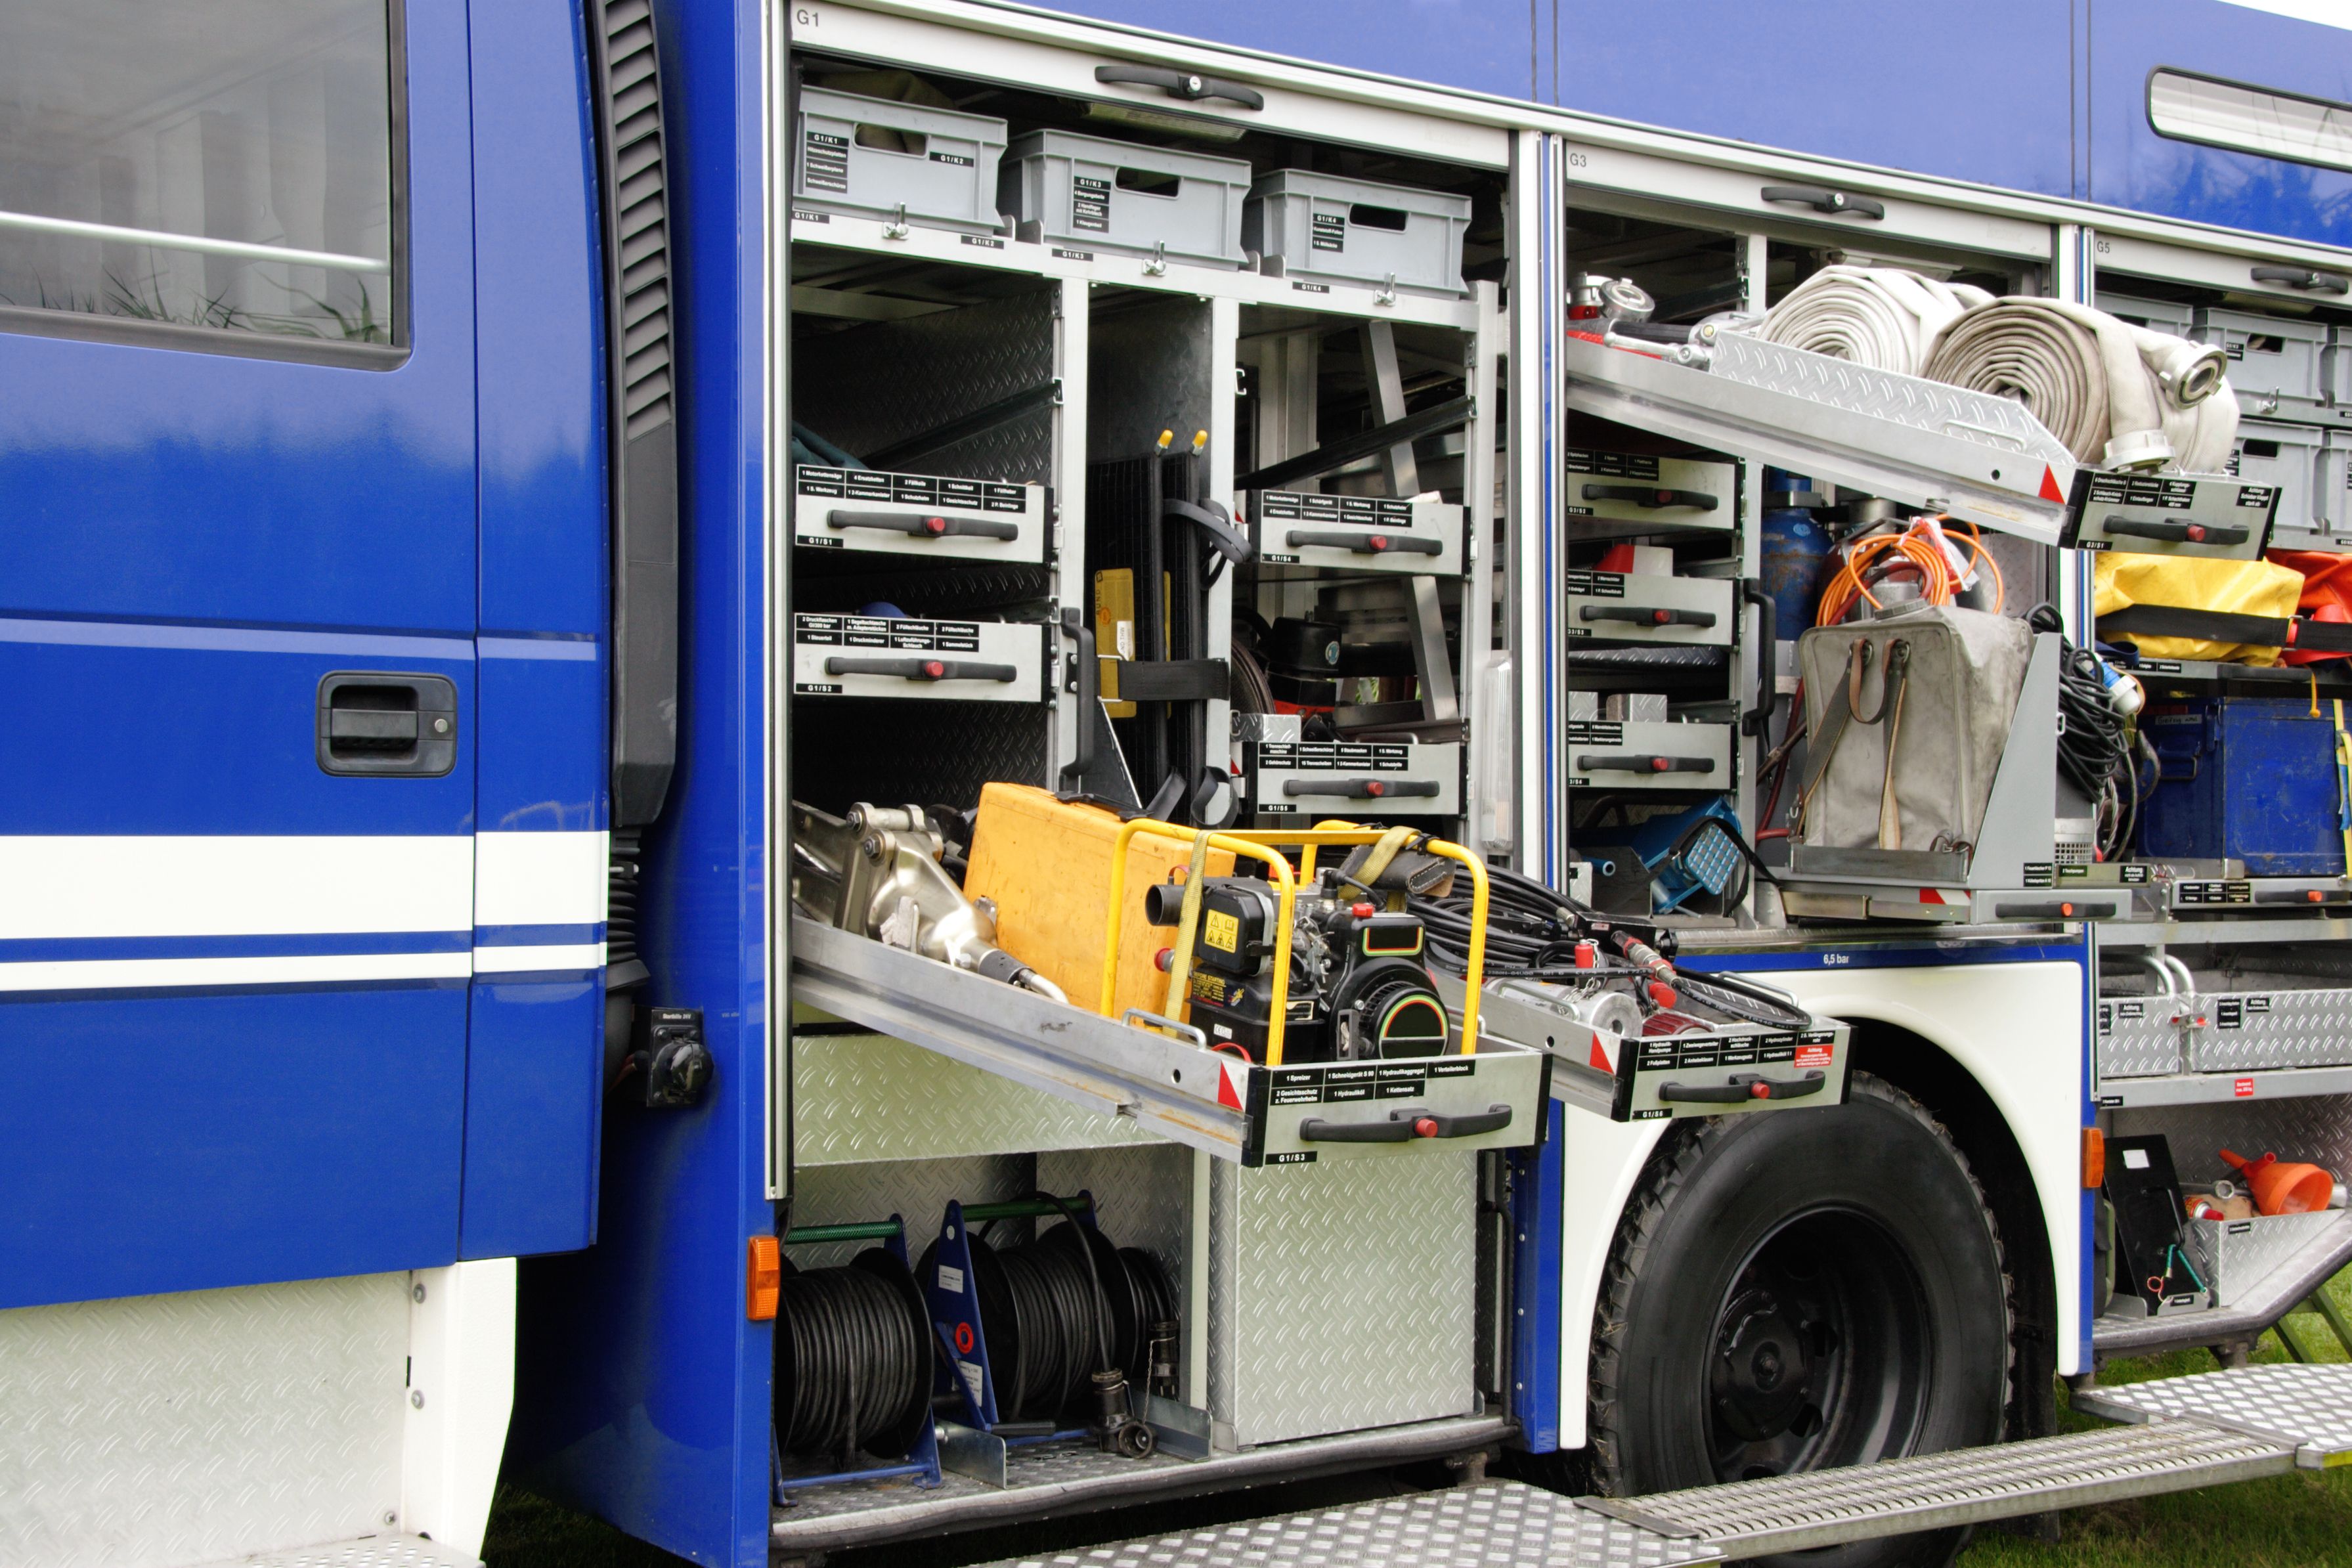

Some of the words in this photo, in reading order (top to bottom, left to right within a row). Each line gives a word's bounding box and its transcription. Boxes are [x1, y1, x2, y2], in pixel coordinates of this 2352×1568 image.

[796, 9, 819, 27] G1
[814, 133, 838, 144] G1/K1
[940, 154, 964, 165] G1/K2
[1569, 153, 1587, 167] G3
[1079, 179, 1102, 188] G1/K3
[795, 211, 819, 222] G1/K1
[1317, 215, 1337, 224] G1/K4
[972, 236, 995, 248] G1/K2
[2097, 240, 2110, 253] G5
[1062, 251, 1084, 259] G1/K3
[1301, 284, 1322, 292] G1/K4
[809, 536, 833, 546] G1/S1
[2086, 540, 2105, 550] G3/S1
[1271, 554, 1292, 563] G1/S4
[808, 684, 832, 693] G1/S2
[1823, 953, 1836, 966] 6,5
[1837, 953, 1849, 963] bar
[1338, 1089, 1365, 1098] Hydrauliköl
[1642, 1110, 1664, 1118] G1/S6
[1278, 1153, 1306, 1163] G1/S3
